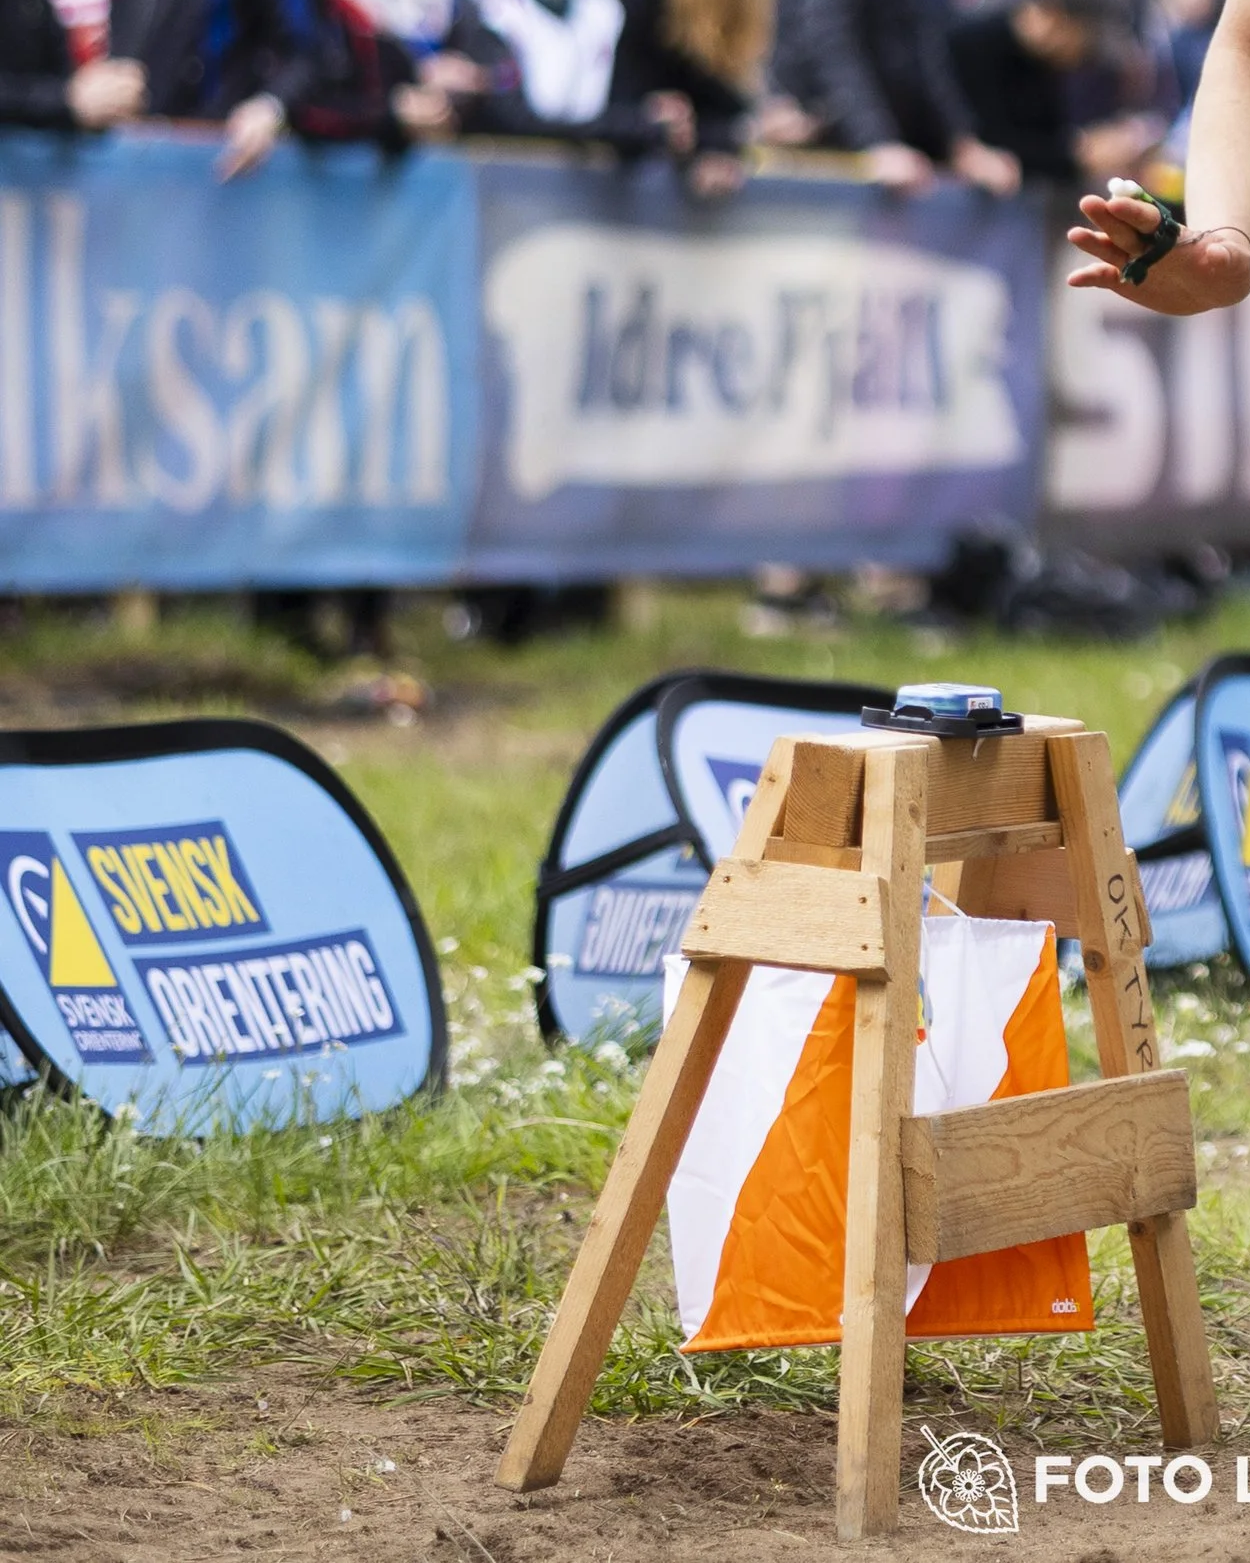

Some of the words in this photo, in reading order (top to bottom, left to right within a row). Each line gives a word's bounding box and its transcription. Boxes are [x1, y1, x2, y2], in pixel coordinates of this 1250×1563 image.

[86, 835, 260, 935] SVENSK
[56, 993, 136, 1028] SVENSK
[146, 939, 395, 1058] ORIENTERING
